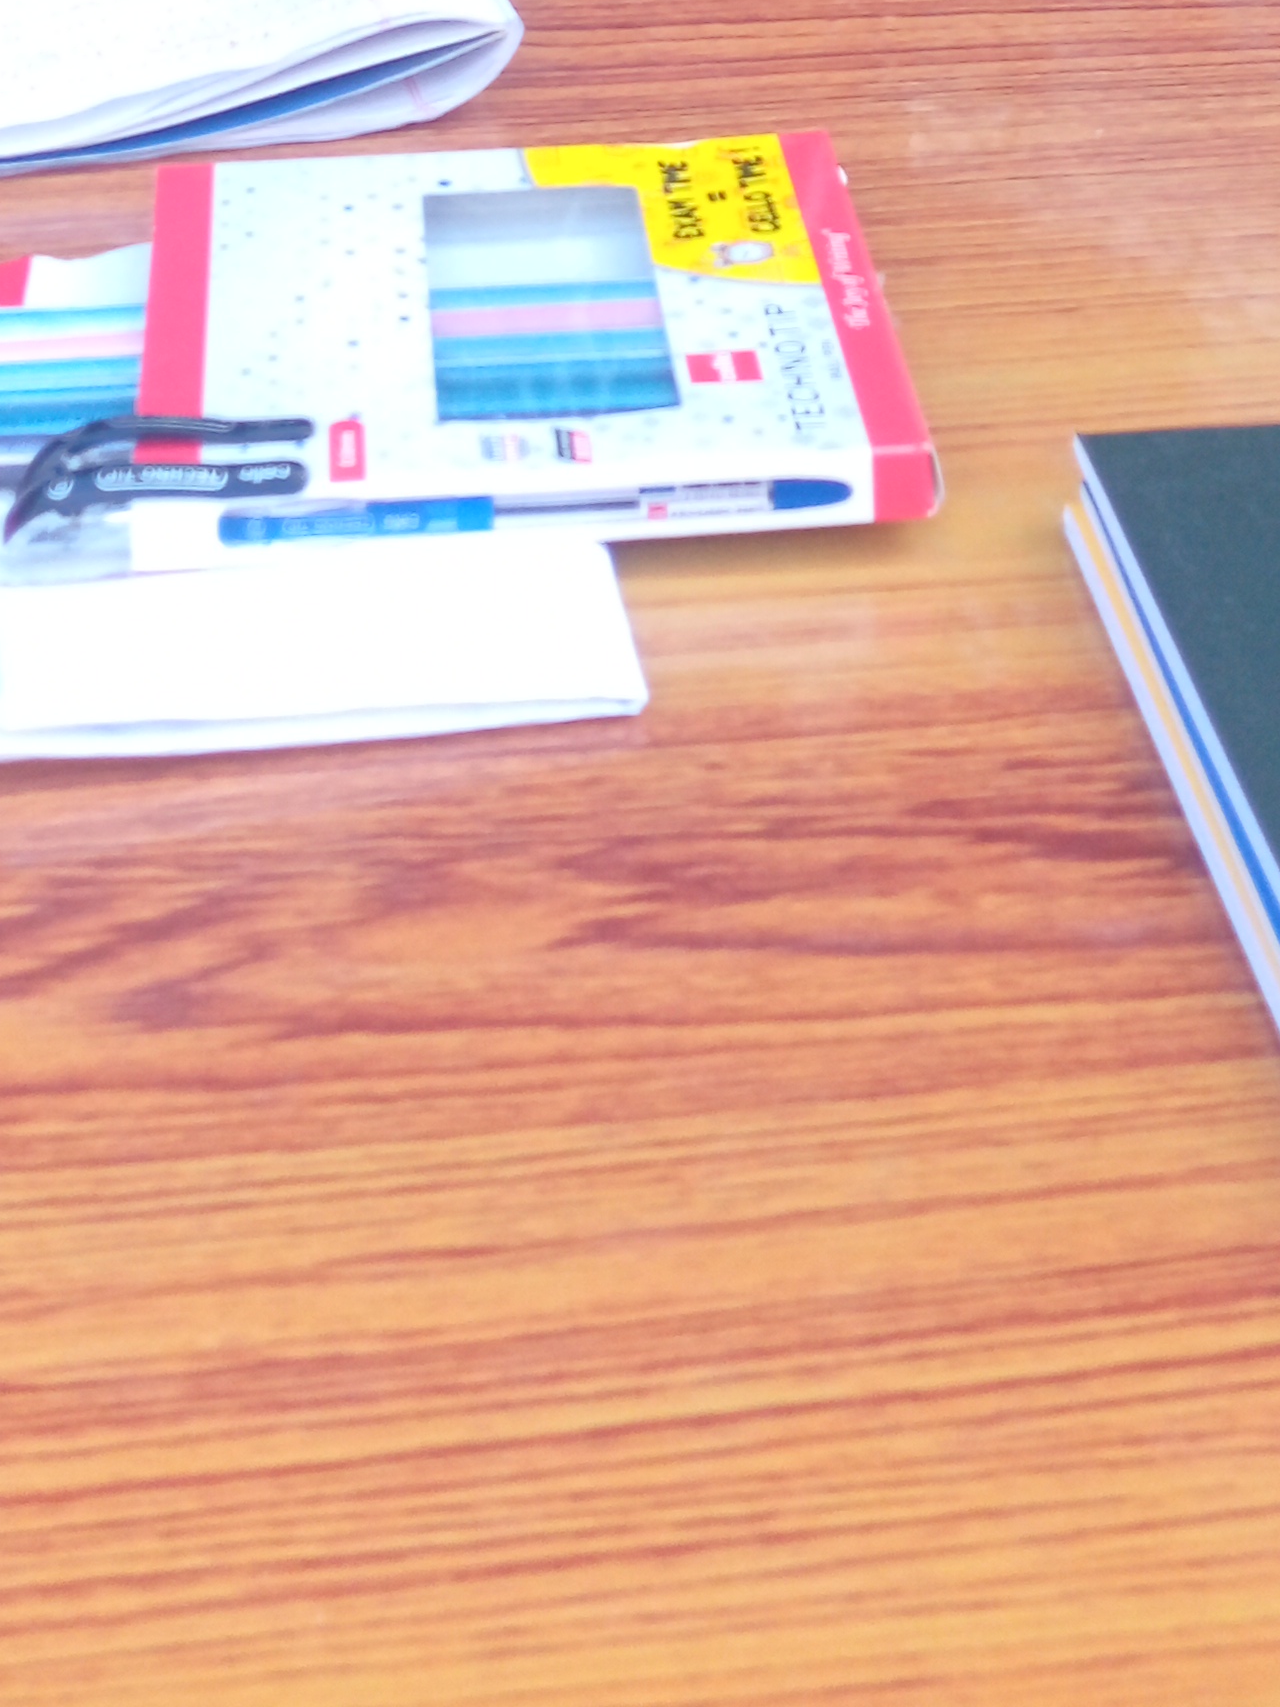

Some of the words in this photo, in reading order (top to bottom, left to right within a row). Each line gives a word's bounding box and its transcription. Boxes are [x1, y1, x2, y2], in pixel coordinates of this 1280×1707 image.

[657, 159, 693, 194] TIME
[668, 198, 706, 240] EXAM
[741, 190, 782, 234] CELLO
